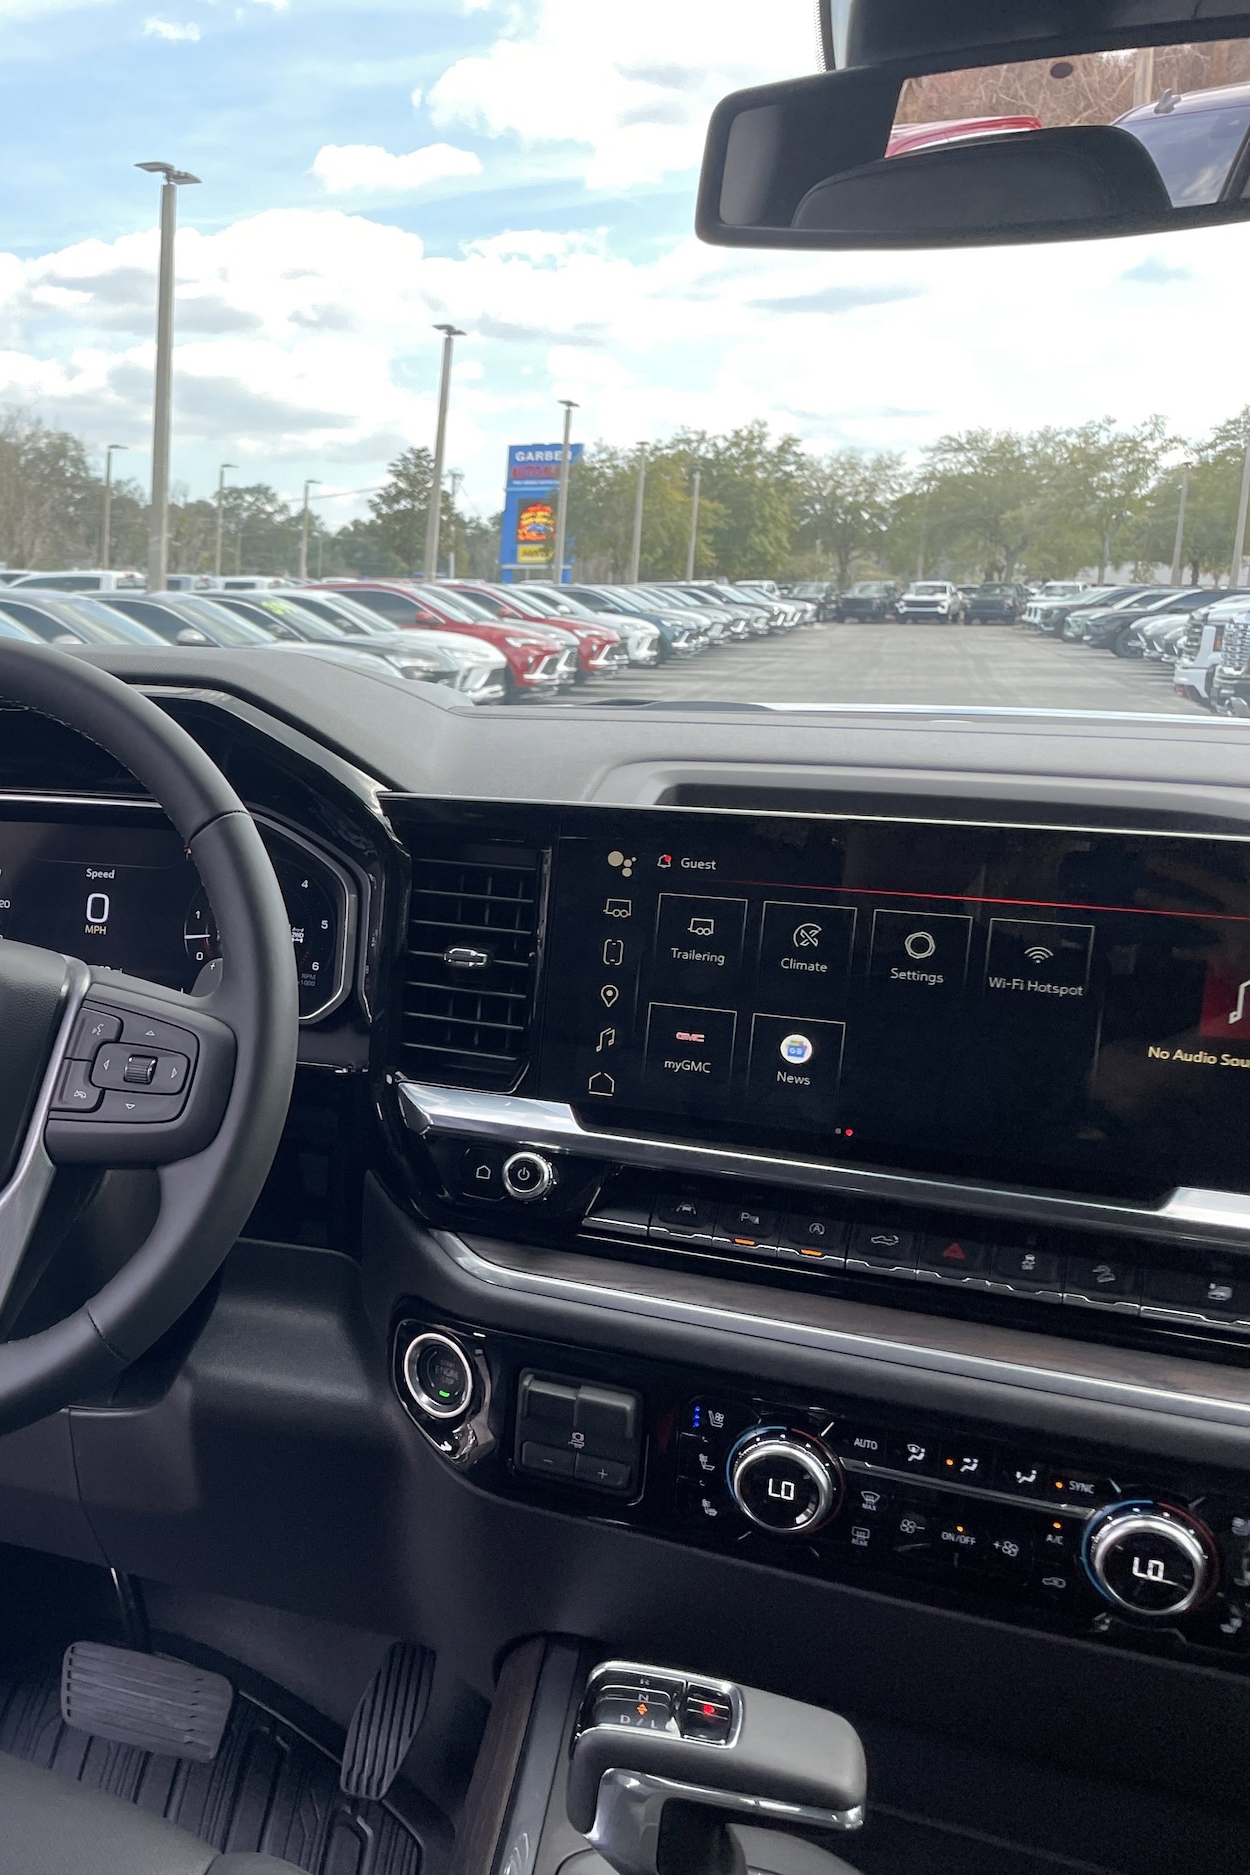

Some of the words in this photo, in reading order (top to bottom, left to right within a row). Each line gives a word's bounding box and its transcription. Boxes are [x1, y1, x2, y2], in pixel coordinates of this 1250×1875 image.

[681, 857, 716, 870] Guest
[86, 868, 115, 879] Speed
[301, 880, 308, 888] 4
[86, 893, 109, 923] 0
[85, 925, 107, 935] MPH
[321, 920, 328, 929] 5
[196, 952, 203, 960] 0
[671, 948, 725, 966] Trailering
[312, 962, 319, 971] 6
[780, 958, 828, 972] Climate
[890, 968, 944, 985] Settings
[989, 977, 1024, 990] Wi-Fi
[1027, 980, 1083, 996] Hotspot
[1148, 1046, 1170, 1059] No
[1172, 1049, 1217, 1064] Audio
[664, 1059, 711, 1073] myGMC
[777, 1071, 811, 1085] News
[854, 1438, 878, 1450] AUTO
[768, 1478, 795, 1500] LO
[1069, 1480, 1095, 1494] SYNC
[941, 1531, 976, 1545] ON/OFF
[1046, 1534, 1064, 1545] A/C
[638, 1693, 649, 1702] N
